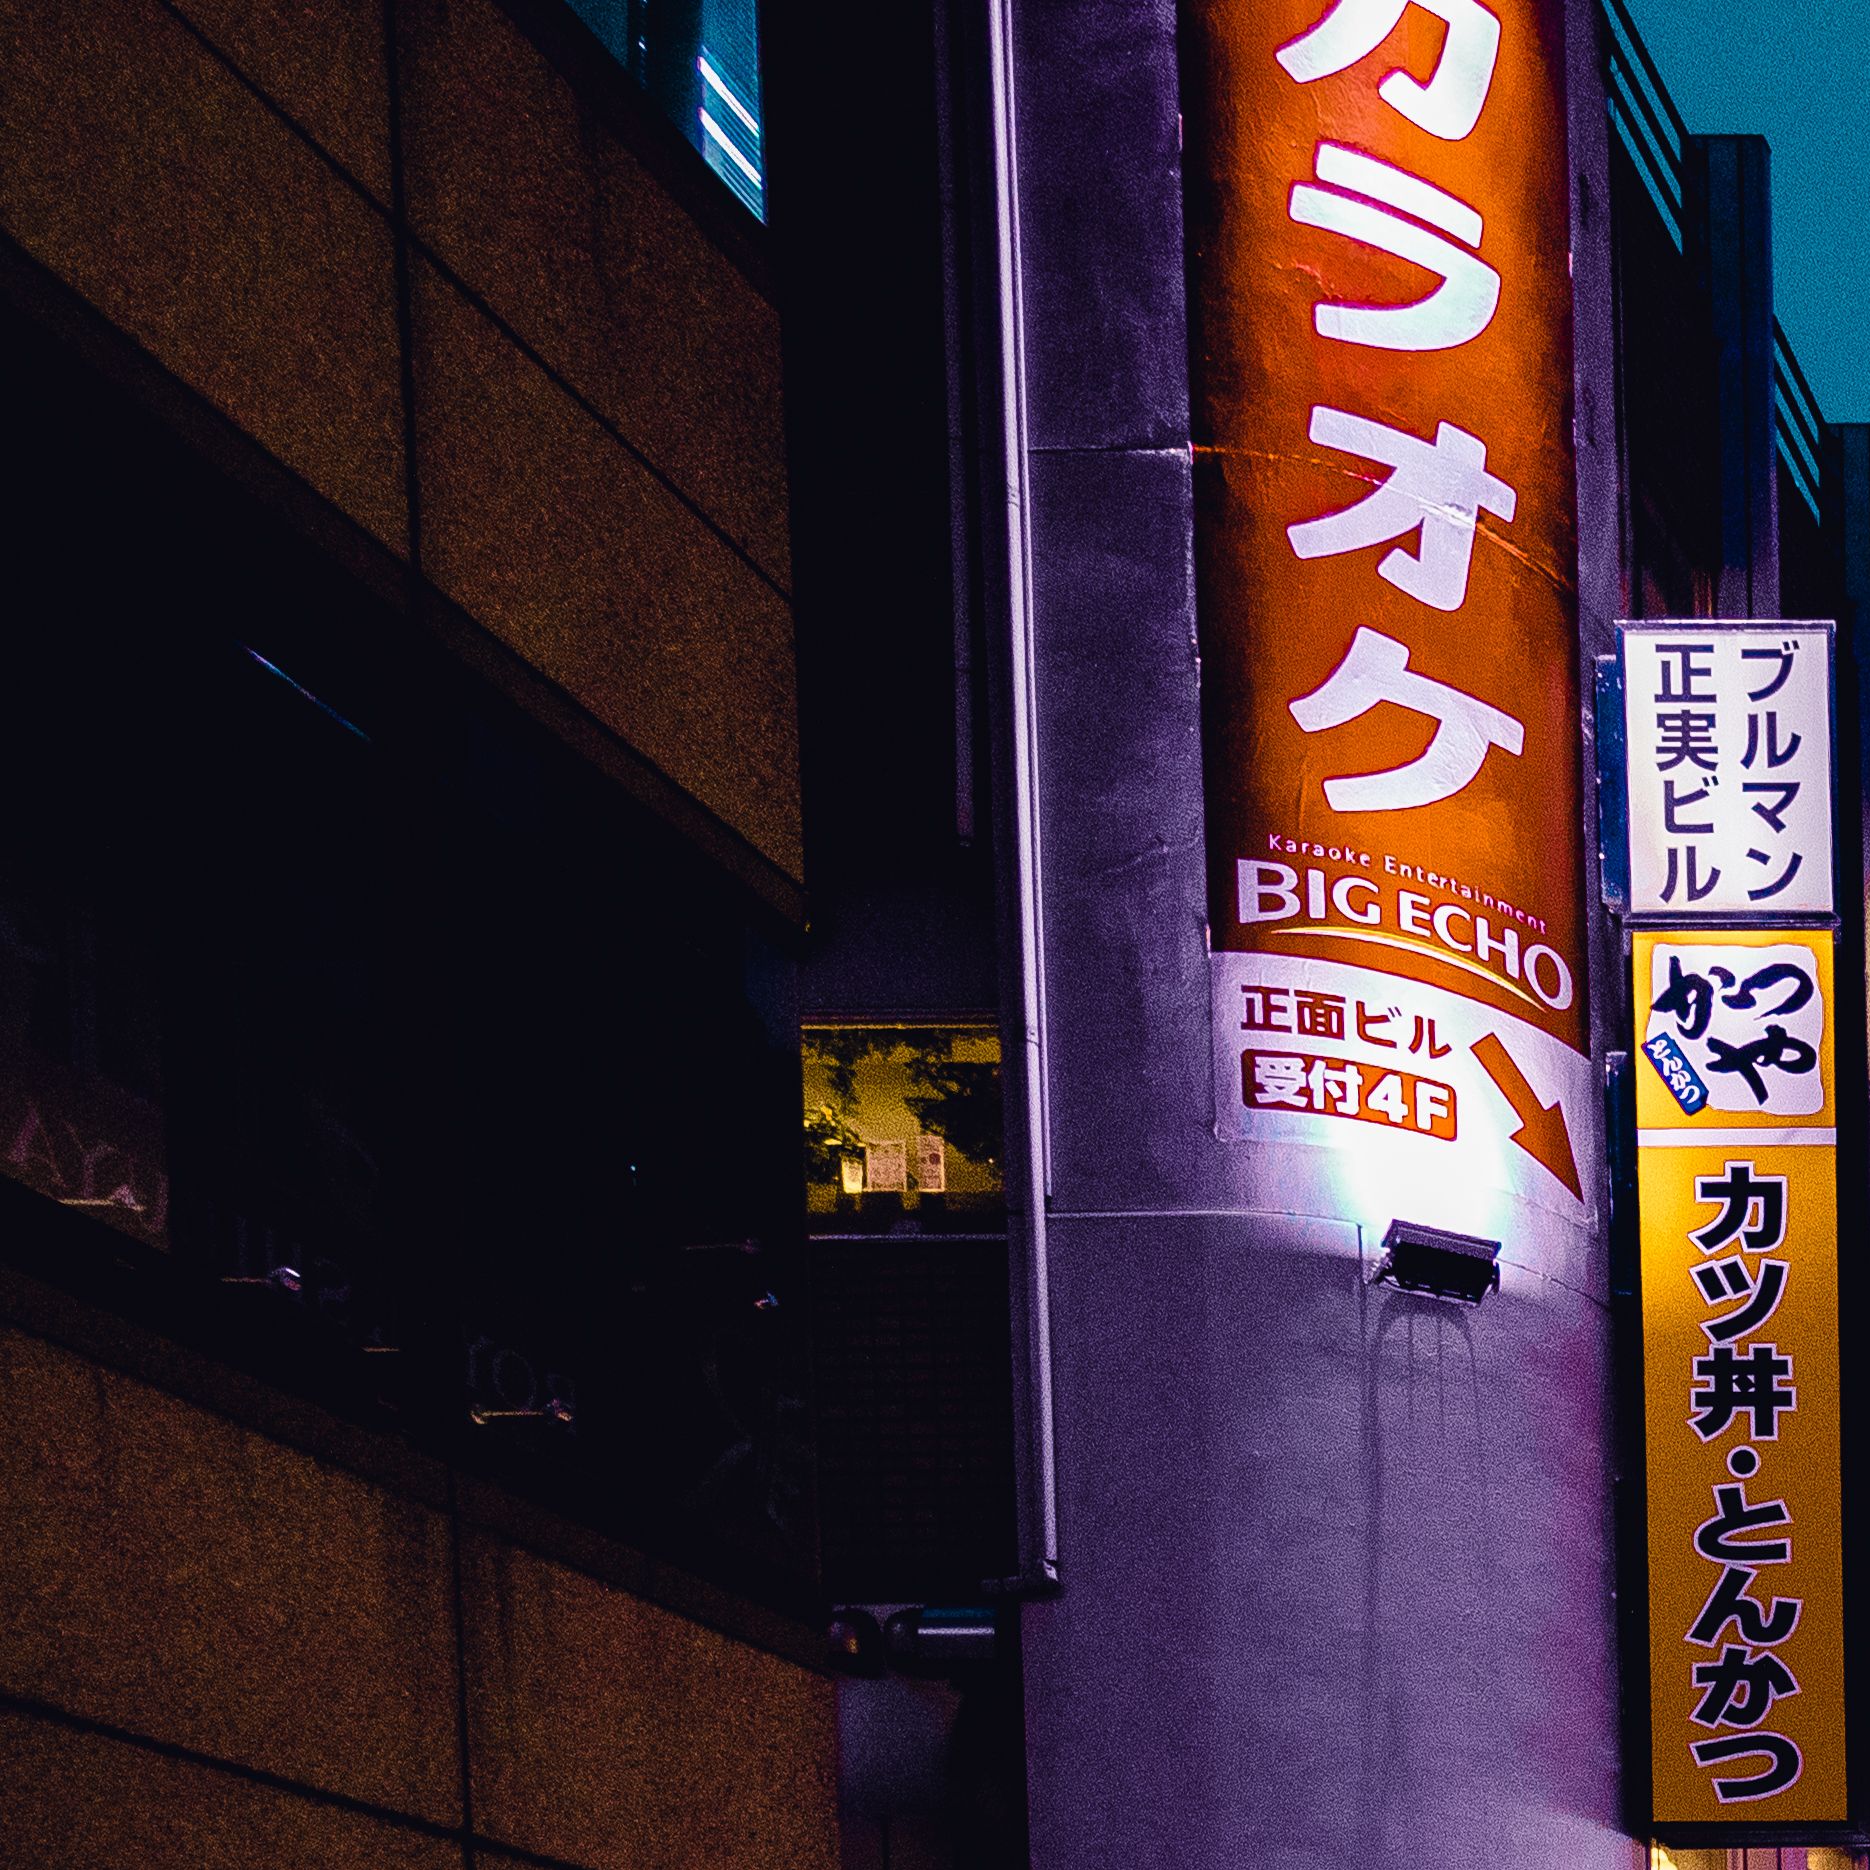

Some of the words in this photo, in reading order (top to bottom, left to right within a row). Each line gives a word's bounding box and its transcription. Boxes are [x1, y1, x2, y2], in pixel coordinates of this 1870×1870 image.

[1276, 0, 1524, 812] カラオケ
[1653, 641, 1720, 904] 正実ビル
[1740, 641, 1803, 902] ブルマン
[1237, 858, 1382, 930] BIG
[1397, 893, 1575, 1012] ECHO
[1268, 832, 1372, 867] Karaoke
[1384, 854, 1548, 935] Entertainment
[1239, 982, 1453, 1060] 正面ビル
[1249, 1054, 1454, 1136] 受付4F
[1689, 1160, 1803, 1805] カツ丼・とんかつ
